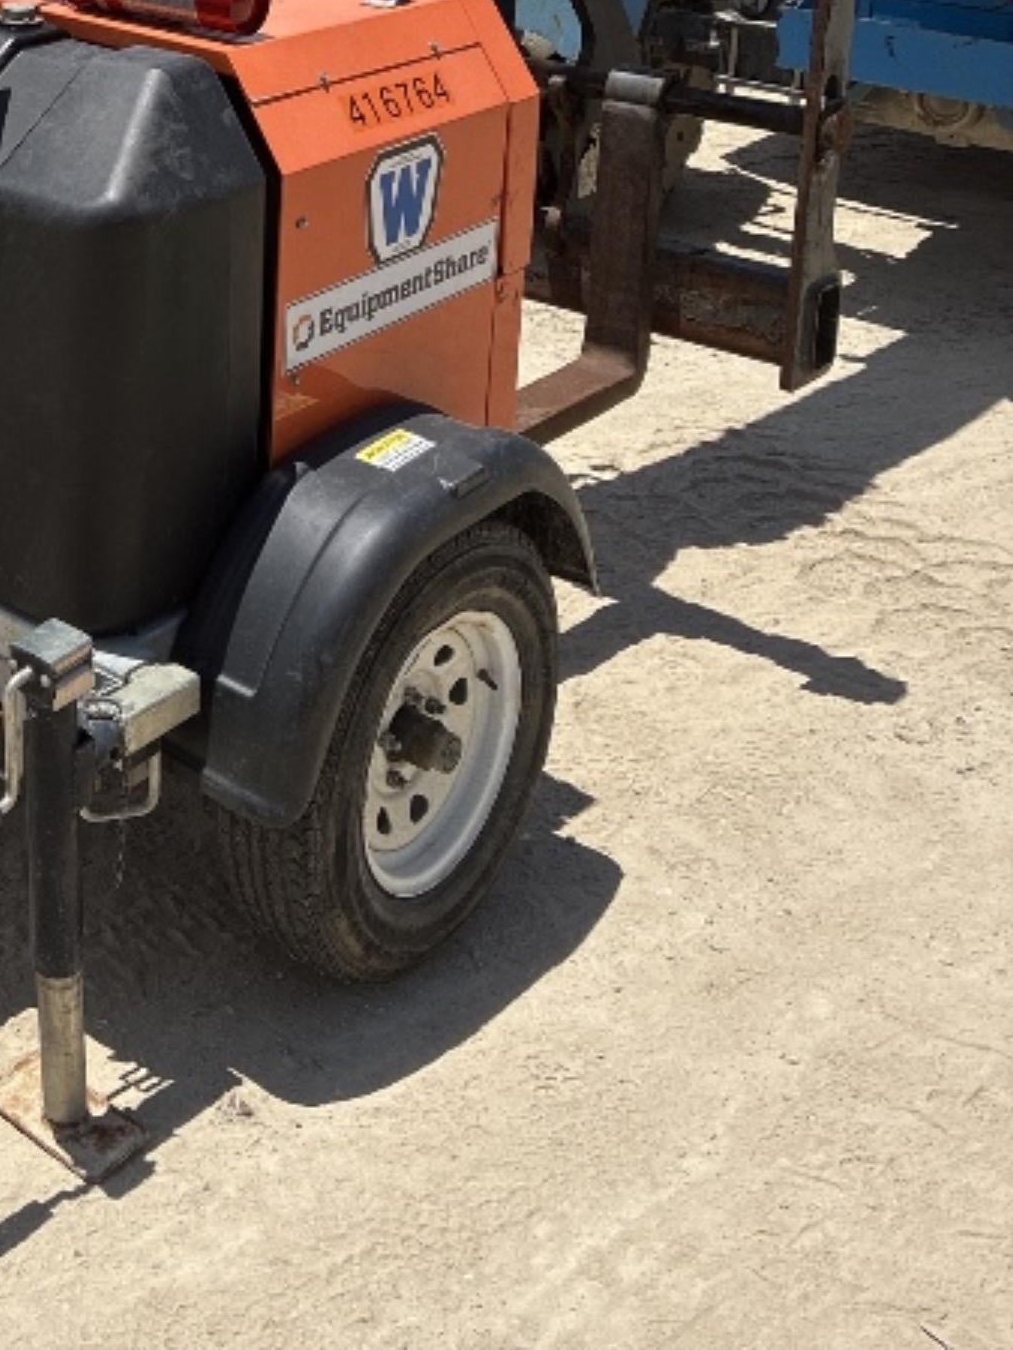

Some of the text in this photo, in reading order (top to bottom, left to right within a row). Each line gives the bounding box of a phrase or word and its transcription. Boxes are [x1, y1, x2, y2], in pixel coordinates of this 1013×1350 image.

[348, 73, 451, 126] 416764
[379, 156, 432, 247] W
[319, 245, 489, 335] EquipmentShare
